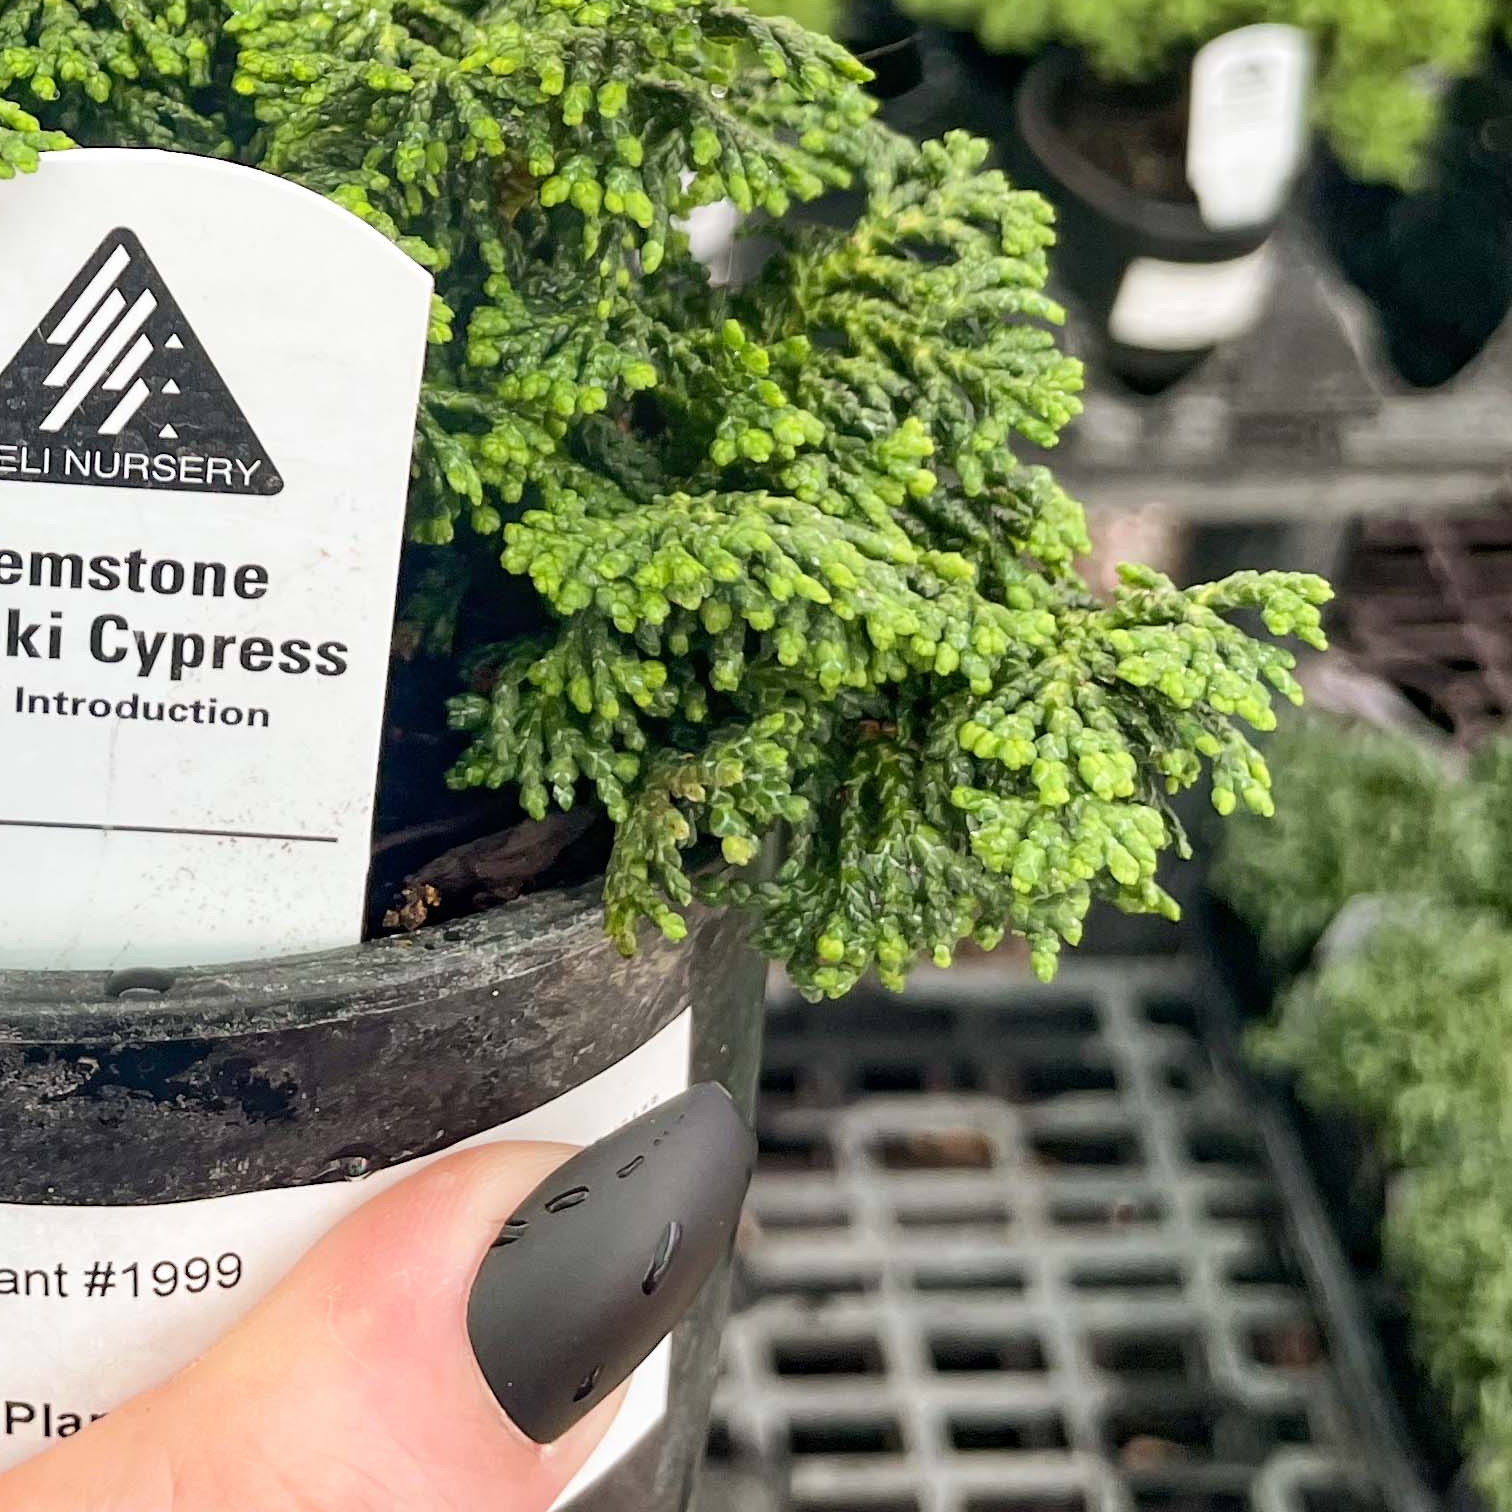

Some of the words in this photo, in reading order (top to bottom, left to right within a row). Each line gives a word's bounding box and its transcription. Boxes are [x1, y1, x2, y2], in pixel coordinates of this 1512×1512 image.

[64, 448, 263, 487] NURSERY
[88, 613, 349, 681] Cypress
[15, 685, 270, 728] Introduction
[83, 1251, 244, 1299] #1999
[4, 1399, 109, 1439] Pla
